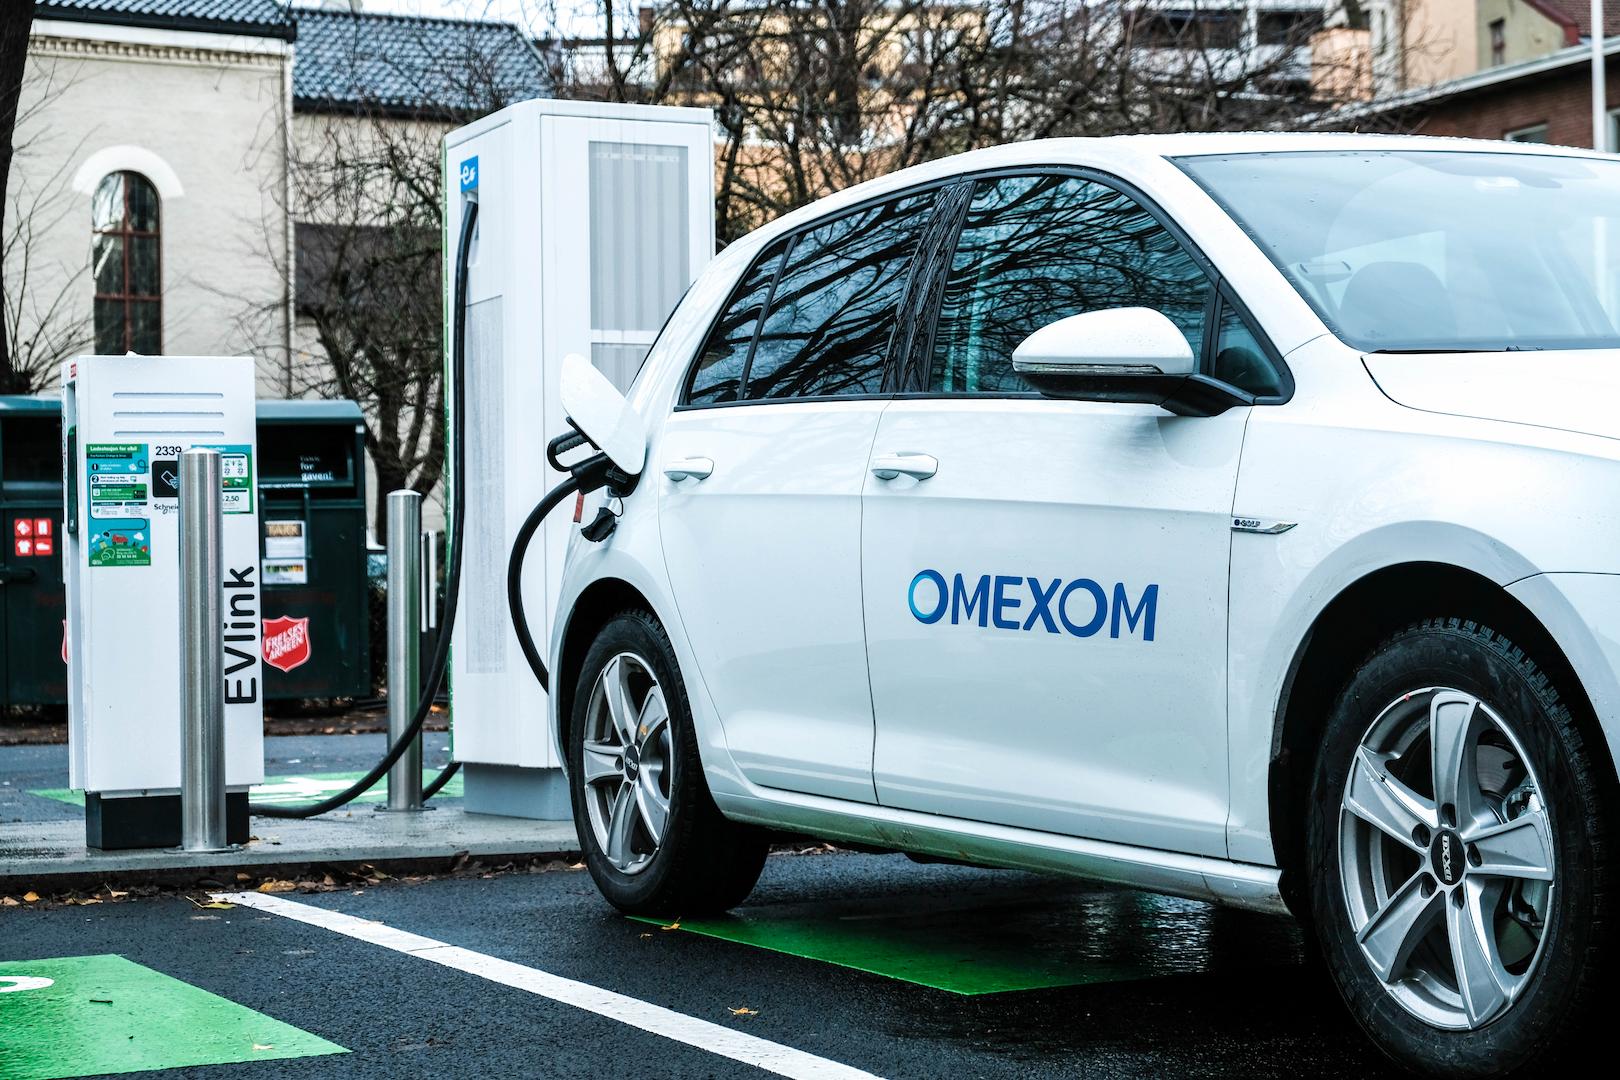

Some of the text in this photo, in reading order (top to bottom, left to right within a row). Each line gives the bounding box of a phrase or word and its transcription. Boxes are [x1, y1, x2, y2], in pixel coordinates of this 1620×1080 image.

[155, 445, 182, 456] 2339
[223, 566, 257, 704] EVlink
[908, 569, 1159, 642] OMEXOM
